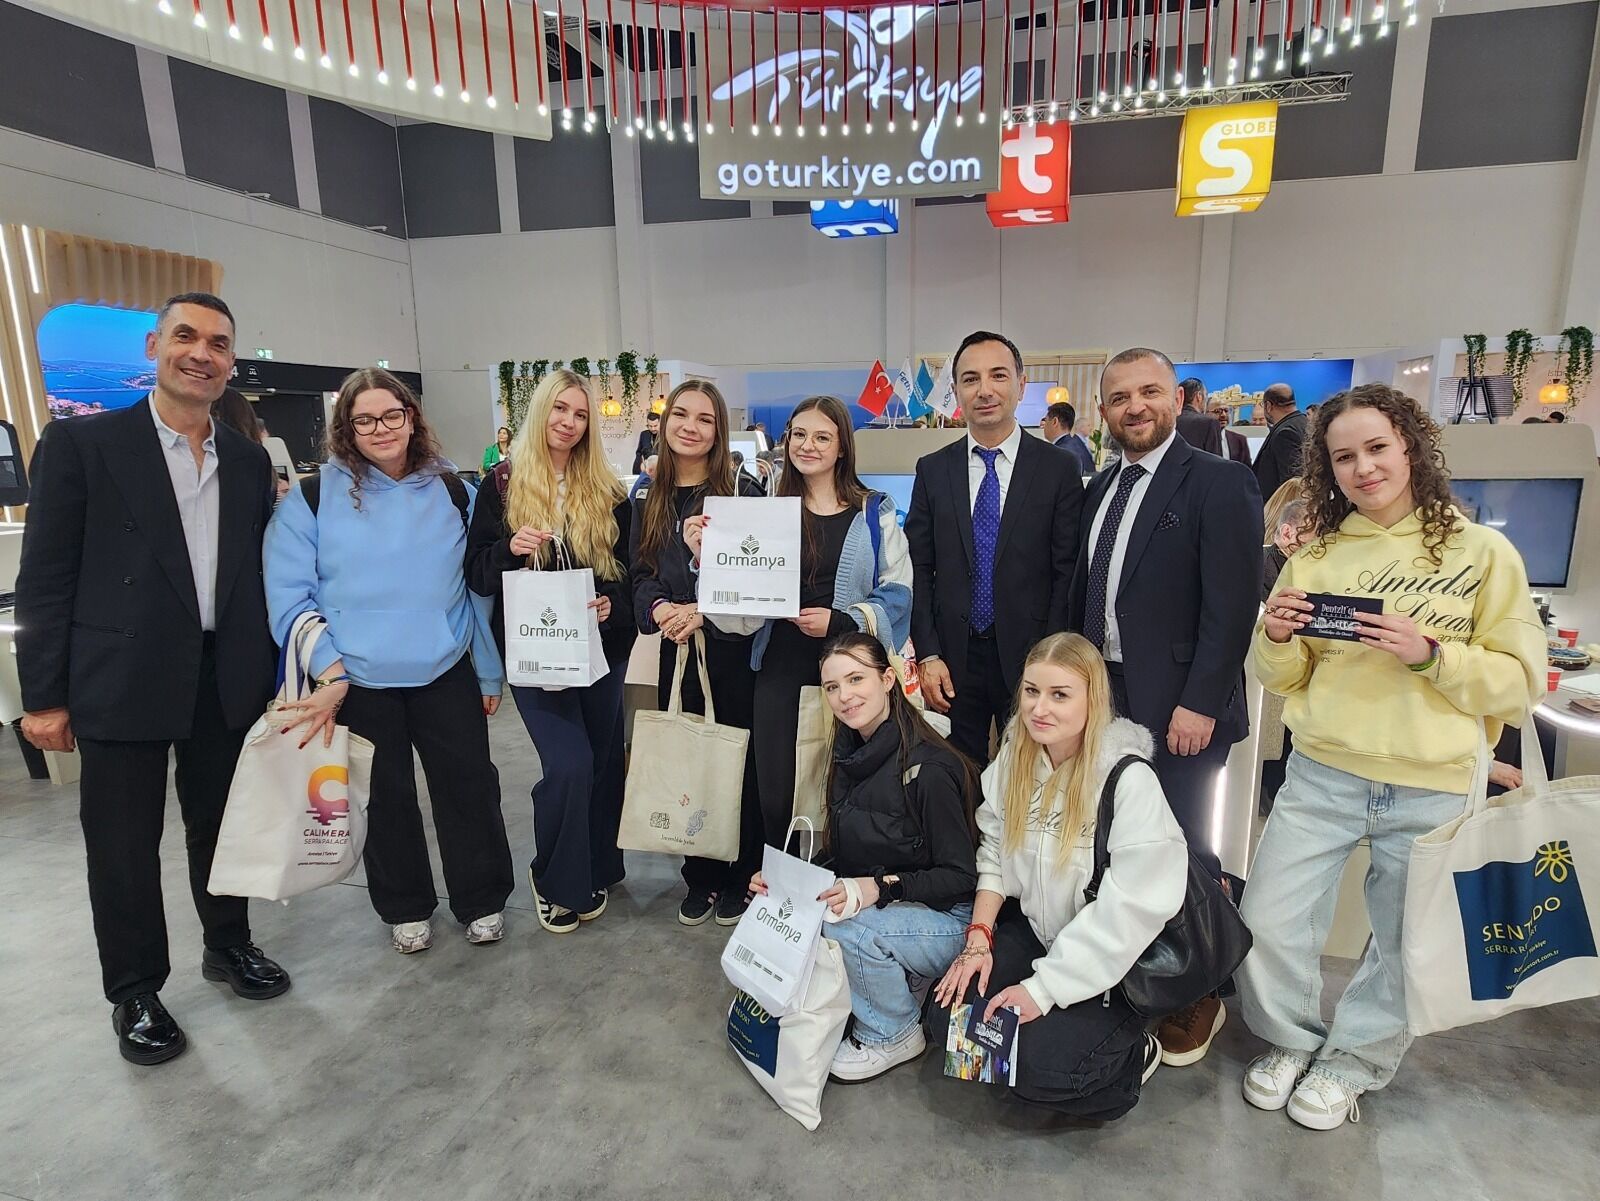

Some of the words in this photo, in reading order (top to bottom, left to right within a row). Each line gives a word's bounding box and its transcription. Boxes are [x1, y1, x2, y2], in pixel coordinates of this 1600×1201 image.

[712, 48, 984, 159] Türkiye
[717, 156, 981, 195] goturkiye.com
[717, 552, 786, 570] Ormanya
[1345, 559, 1483, 600] Amidst
[519, 624, 579, 641] Ormanya
[303, 828, 351, 838] CALIMERA
[756, 906, 802, 944] Ormanya
[1484, 944, 1517, 955] SERRA
